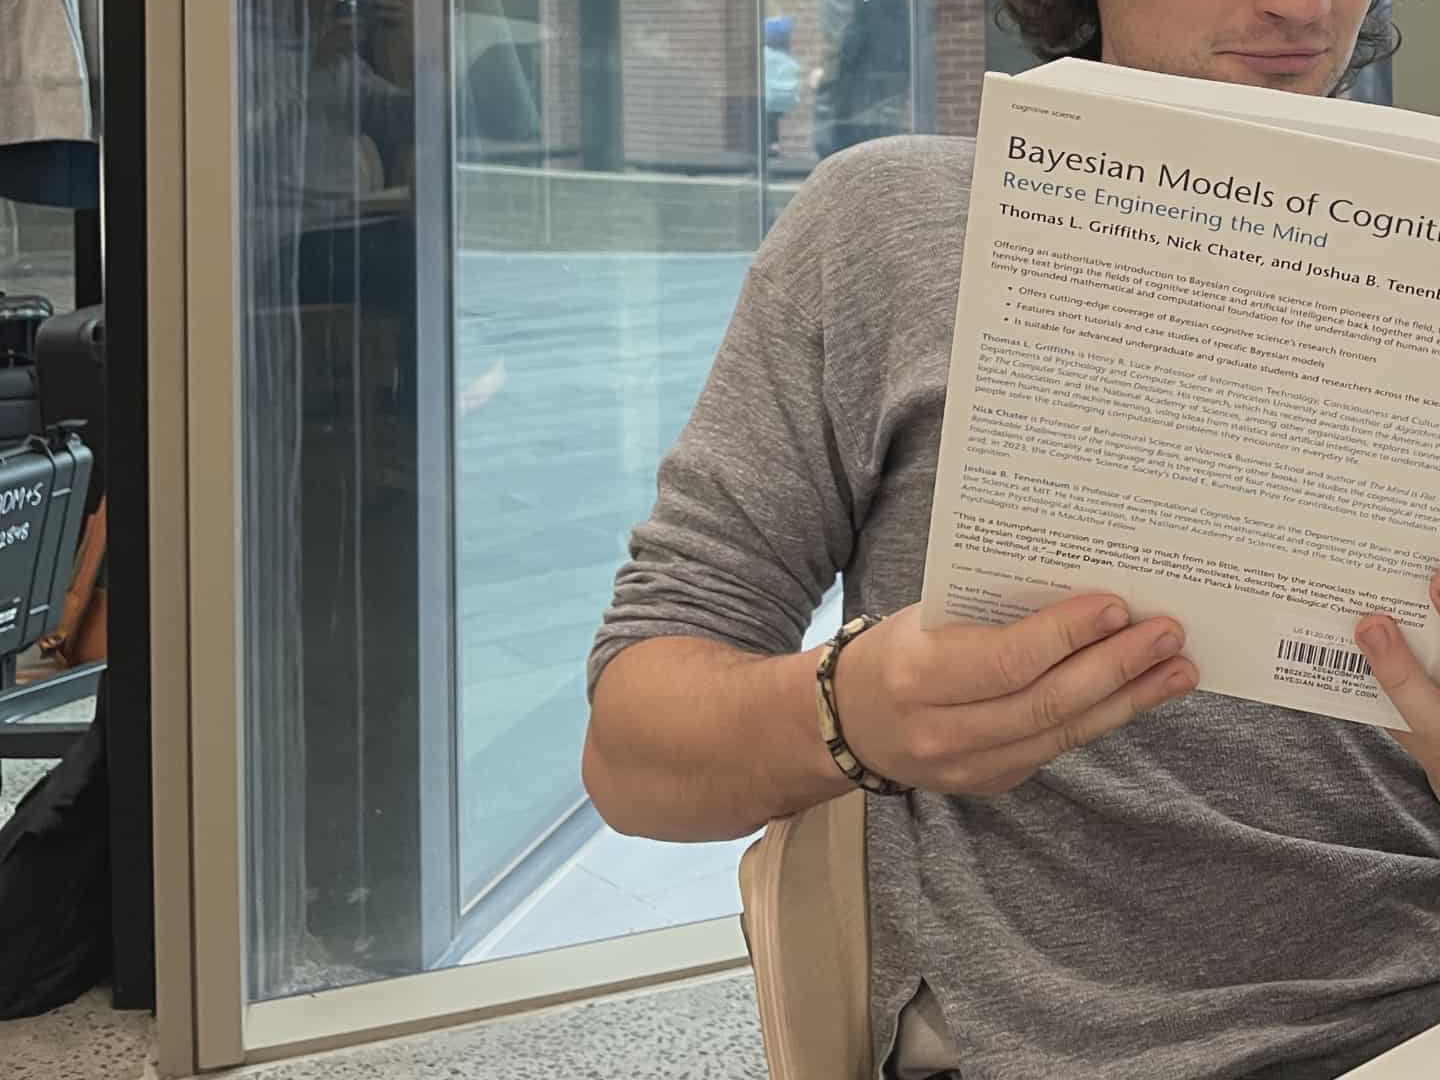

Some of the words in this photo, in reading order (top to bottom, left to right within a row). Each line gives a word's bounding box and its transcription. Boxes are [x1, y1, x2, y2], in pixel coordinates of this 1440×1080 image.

[1002, 170, 1086, 203] Reverse
[1093, 187, 1222, 234] Engineering
[1230, 214, 1265, 237] the
[1271, 221, 1328, 249] Mind
[1007, 134, 1145, 185] Bayesian
[1157, 162, 1275, 210] Models
[1284, 189, 1319, 218] of
[993, 239, 1035, 257] Offering
[1050, 251, 1112, 269] authoritative
[1114, 262, 1174, 281] introduction
[1188, 276, 1231, 292] Bayesian
[1231, 286, 1276, 301] cognitive
[1277, 295, 1313, 308] science
[1314, 300, 1338, 313] from
[1338, 307, 1381, 322] pioneers
[1393, 317, 1410, 328] the
[998, 202, 1064, 226] Thomas
[1069, 215, 1081, 230] L.
[1088, 218, 1159, 246] Griffiths,
[1166, 233, 1202, 252] Nick
[1206, 241, 1264, 267] Chater,
[1270, 256, 1303, 272] and
[1306, 261, 1360, 284] Joshua
[1365, 273, 1379, 288] B.
[991, 260, 1019, 276] firmly
[1020, 267, 1068, 283] grounded
[1069, 277, 1135, 296] mathematical
[1136, 289, 1156, 300] and
[1156, 293, 1226, 313] computational
[1226, 305, 1279, 324] foundation
[1280, 316, 1294, 327] for
[1296, 320, 1313, 330] the
[1313, 324, 1382, 346] understanding
[1395, 339, 1430, 354] human
[992, 249, 1030, 264] hensive
[1031, 257, 1051, 268] text
[1053, 260, 1084, 276] brings
[1085, 267, 1103, 278] the
[1104, 270, 1131, 283] fields
[1144, 280, 1190, 295] cognitive
[1191, 289, 1227, 302] science
[1228, 296, 1248, 306] and
[1249, 300, 1288, 314] artificial
[1289, 307, 1345, 326] intelligence
[1346, 318, 1370, 331] back
[1371, 324, 1413, 339] together
[1415, 334, 1435, 344] and
[1016, 301, 1056, 316] Features
[1057, 310, 1082, 321] short
[1083, 314, 1123, 329] tutorials
[1123, 323, 1143, 333] and
[1144, 327, 1165, 337] case
[1167, 331, 1200, 344] studies
[1213, 340, 1248, 353] specific
[1249, 346, 1290, 361] Bayesian
[1291, 355, 1325, 368] models
[1018, 286, 1048, 299] Offers
[1049, 293, 1110, 312] cutting-edge
[1111, 305, 1155, 321] coverage
[1168, 314, 1209, 330] Bayesian
[1210, 324, 1254, 339] cognitive
[1297, 341, 1338, 355] research
[1338, 348, 1377, 364] frontiers
[1024, 319, 1061, 333] suitable
[1062, 325, 1076, 336] for
[1078, 329, 1124, 345] advanced
[1125, 339, 1195, 358] undergraduate
[1195, 352, 1215, 362] and
[1215, 356, 1258, 371] graduate
[1259, 365, 1299, 379] students
[1300, 373, 1320, 383] and
[1321, 377, 1373, 394] researchers
[1374, 388, 1403, 400] across
[1404, 393, 1421, 404] the
[0, 482, 43, 513] DM+S
